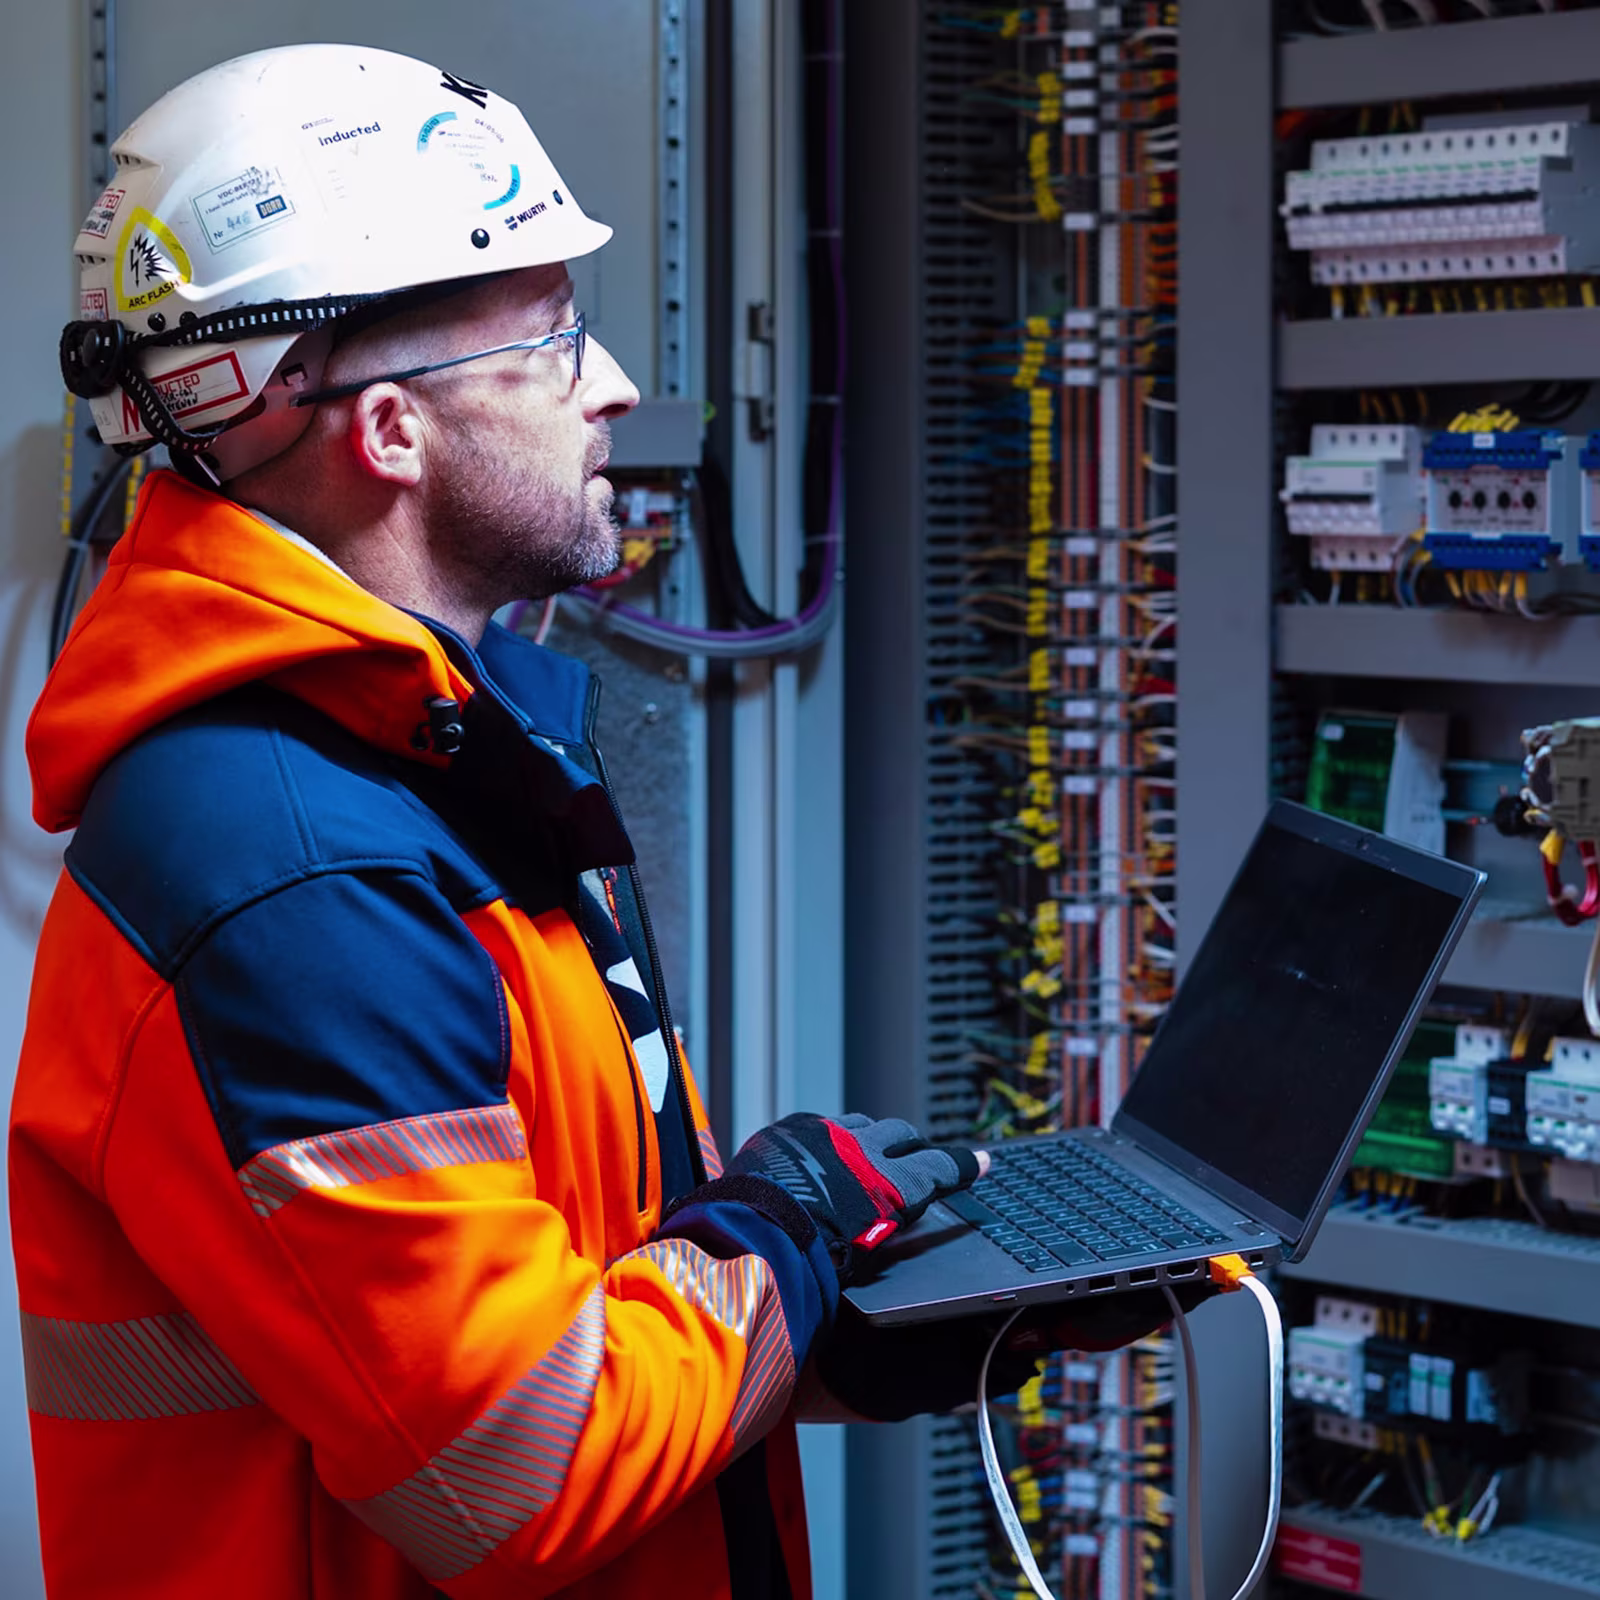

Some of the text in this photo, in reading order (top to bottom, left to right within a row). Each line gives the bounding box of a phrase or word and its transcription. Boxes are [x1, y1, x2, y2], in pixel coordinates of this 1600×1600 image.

[317, 121, 382, 148] Inducted
[213, 230, 224, 240] Nr
[128, 280, 180, 309] ARC FLASH
